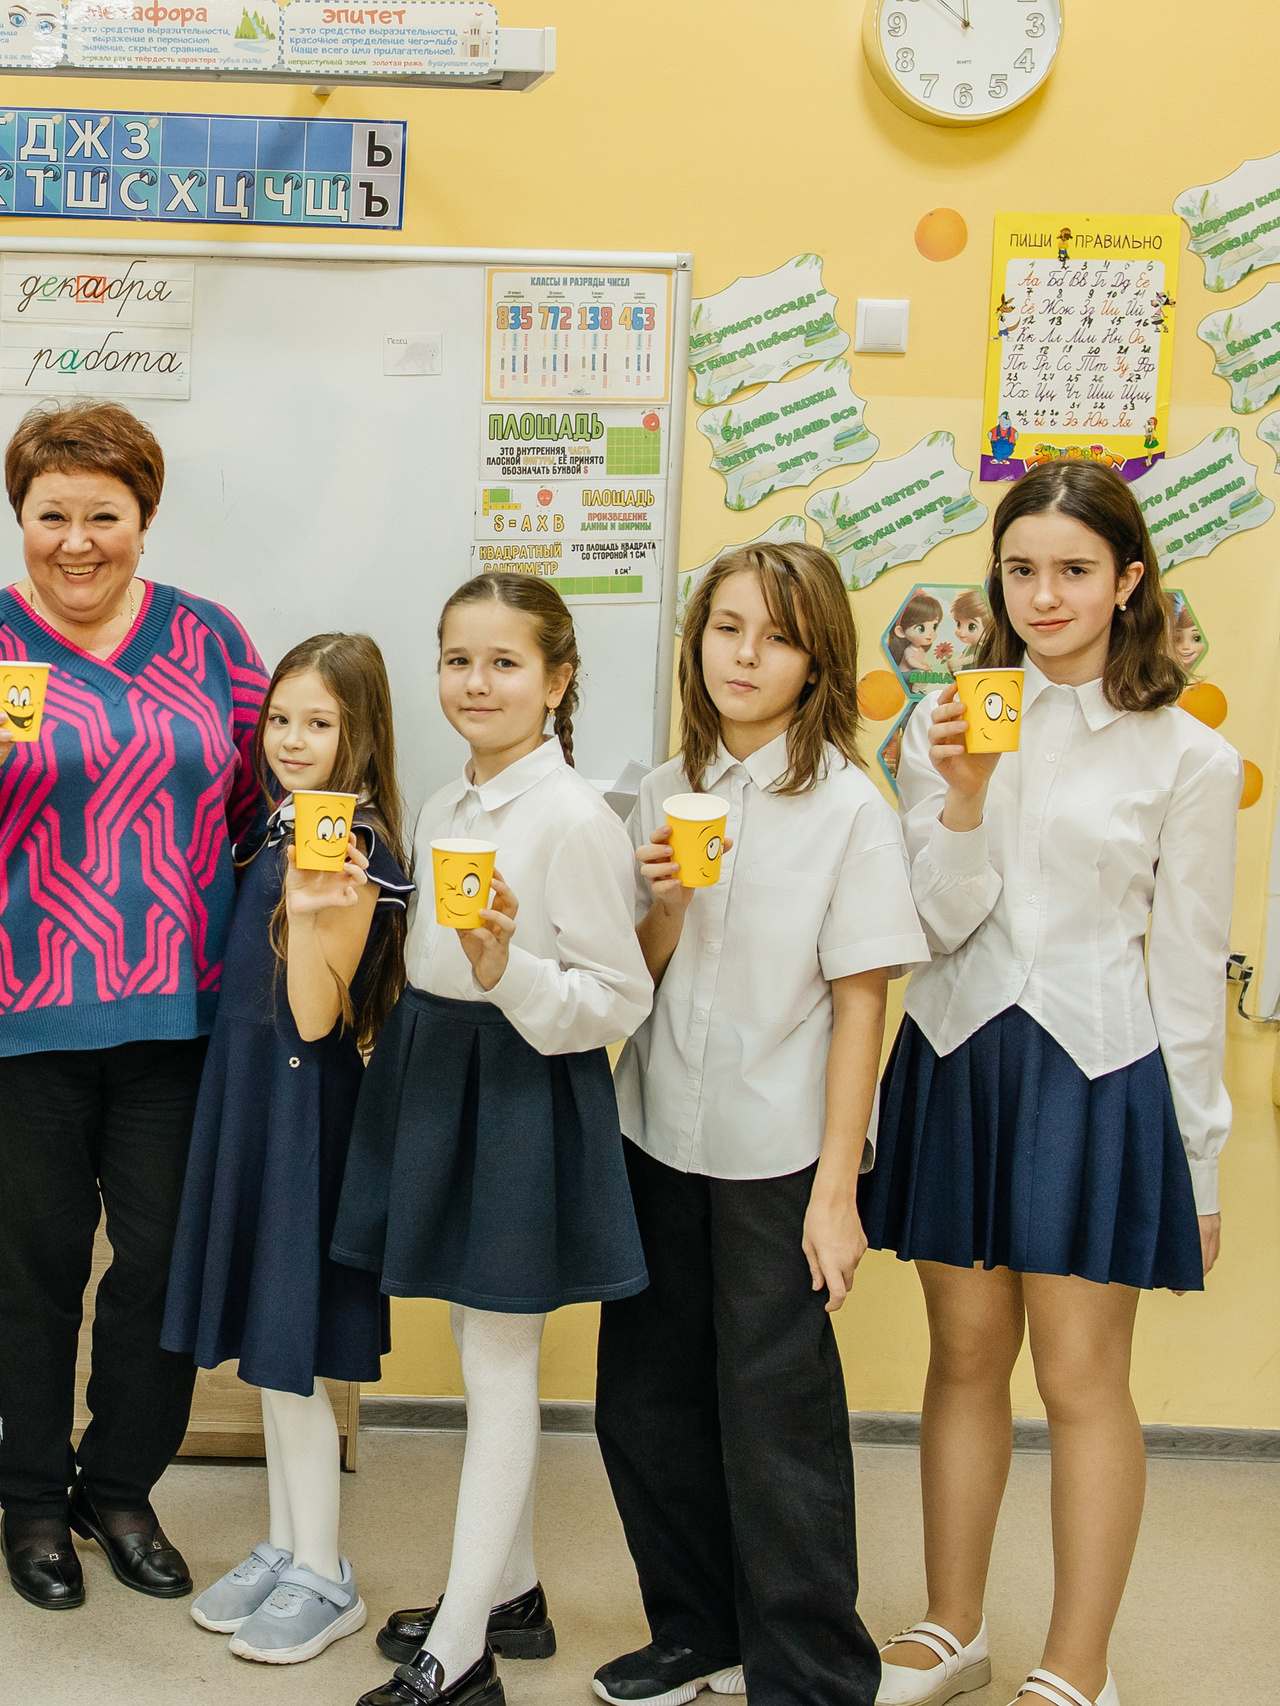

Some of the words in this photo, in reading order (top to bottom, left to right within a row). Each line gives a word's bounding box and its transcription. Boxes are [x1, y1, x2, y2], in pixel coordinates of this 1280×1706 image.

[322, 8, 406, 24] эпитет
[887, 12, 908, 37] 9
[1026, 12, 1046, 38] 3
[147, 28, 230, 36] выразительности,
[157, 37, 210, 45] переносном
[290, 37, 339, 46] красочное
[342, 38, 404, 46] определение
[369, 28, 458, 36] выразительности,
[171, 46, 220, 54] сравнение.
[374, 48, 455, 56] прилагательное).
[895, 48, 914, 72] 8
[1014, 48, 1035, 73] 4
[920, 74, 940, 98] 7
[953, 82, 974, 108] 6
[988, 74, 1008, 98] 5
[19, 118, 57, 162] Д
[66, 119, 110, 160] Ж
[120, 120, 150, 161] З
[368, 130, 392, 169] Ь
[26, 168, 56, 207] Т
[66, 169, 108, 210] Ш
[120, 170, 150, 211] С
[165, 174, 200, 212] Х
[214, 176, 249, 218] Ц
[264, 176, 294, 215] Ч
[306, 178, 349, 221] Щ
[360, 182, 389, 218] Ъ
[1192, 202, 1254, 238] Хорошая
[1010, 234, 1052, 247] ПИШИ
[1075, 234, 1162, 250] ПРАВИЛЬНО
[17, 260, 172, 318] декабря
[530, 277, 561, 286] КЛАССЫ
[570, 278, 606, 288] РАЗРЯДЫ
[607, 278, 630, 287] ЧИСЕЛ
[496, 306, 532, 330] 835
[538, 306, 572, 330] 772
[578, 306, 612, 330] 138
[618, 307, 656, 330] 463
[714, 314, 762, 343] умного
[764, 293, 816, 320] соседа
[707, 342, 757, 371] книгой
[756, 312, 834, 351] побеседуй
[1226, 328, 1272, 356] Книга
[25, 331, 182, 387] работа
[1232, 364, 1258, 382] без
[721, 410, 780, 442] Будешь
[780, 387, 837, 415] книжки
[488, 412, 604, 442] ПЛОЩАДЬ
[721, 441, 776, 468] читать,
[775, 417, 830, 448] будешь
[830, 406, 858, 424] все
[486, 456, 520, 465] ПЛОСКОЙ
[558, 455, 568, 464] ЕЁ
[570, 456, 604, 465] ПРИНЯТО
[500, 447, 514, 456] ЭТО
[516, 447, 565, 456] ВНУТРЕННЯЯ
[568, 446, 592, 455] ЧАСТЬ
[778, 450, 818, 473] знать
[502, 466, 550, 475] ОБОЗНАЧАТЬ
[552, 464, 581, 474] БУКВОЙ
[1165, 453, 1234, 500] добывают
[582, 490, 655, 507] ПЛОЩАДЬ
[836, 502, 882, 530] Книги
[881, 478, 930, 508] читать
[1189, 502, 1200, 513] а
[1198, 476, 1246, 508] знания
[580, 522, 608, 531] ДЛИНЫ
[619, 522, 652, 530] ШИРИНЫ
[588, 512, 648, 522] ПРОИЗВЕДЕНИЕ
[853, 523, 896, 552] скуки
[895, 514, 913, 530] не
[912, 494, 952, 520] знать
[480, 542, 562, 560] КВАДРАТНЫЙ
[586, 543, 619, 552] ПЛОЩАДЬ
[621, 542, 656, 551] КВАДРАТА
[592, 551, 627, 560] СТОРОНОЙ
[1166, 538, 1184, 554] из
[484, 562, 558, 576] САНТИМЕТР
